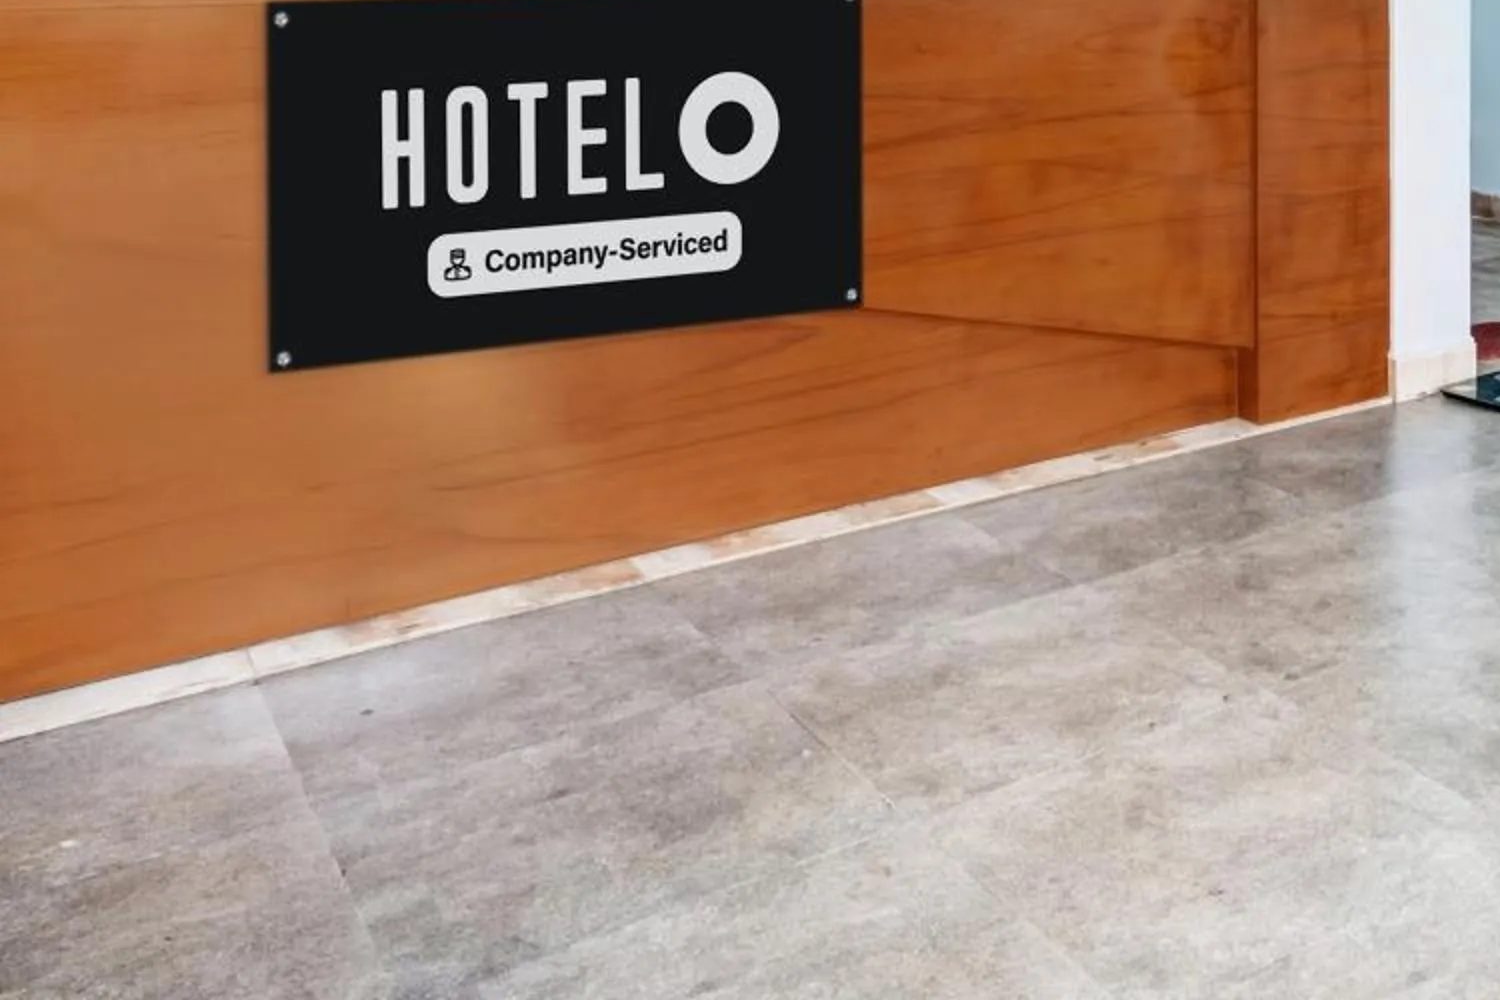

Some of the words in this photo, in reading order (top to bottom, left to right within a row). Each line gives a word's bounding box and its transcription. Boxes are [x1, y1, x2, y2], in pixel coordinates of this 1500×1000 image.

[381, 77, 665, 210] HOTEL
[678, 71, 780, 185] O
[485, 228, 728, 274] Company-Serviced
